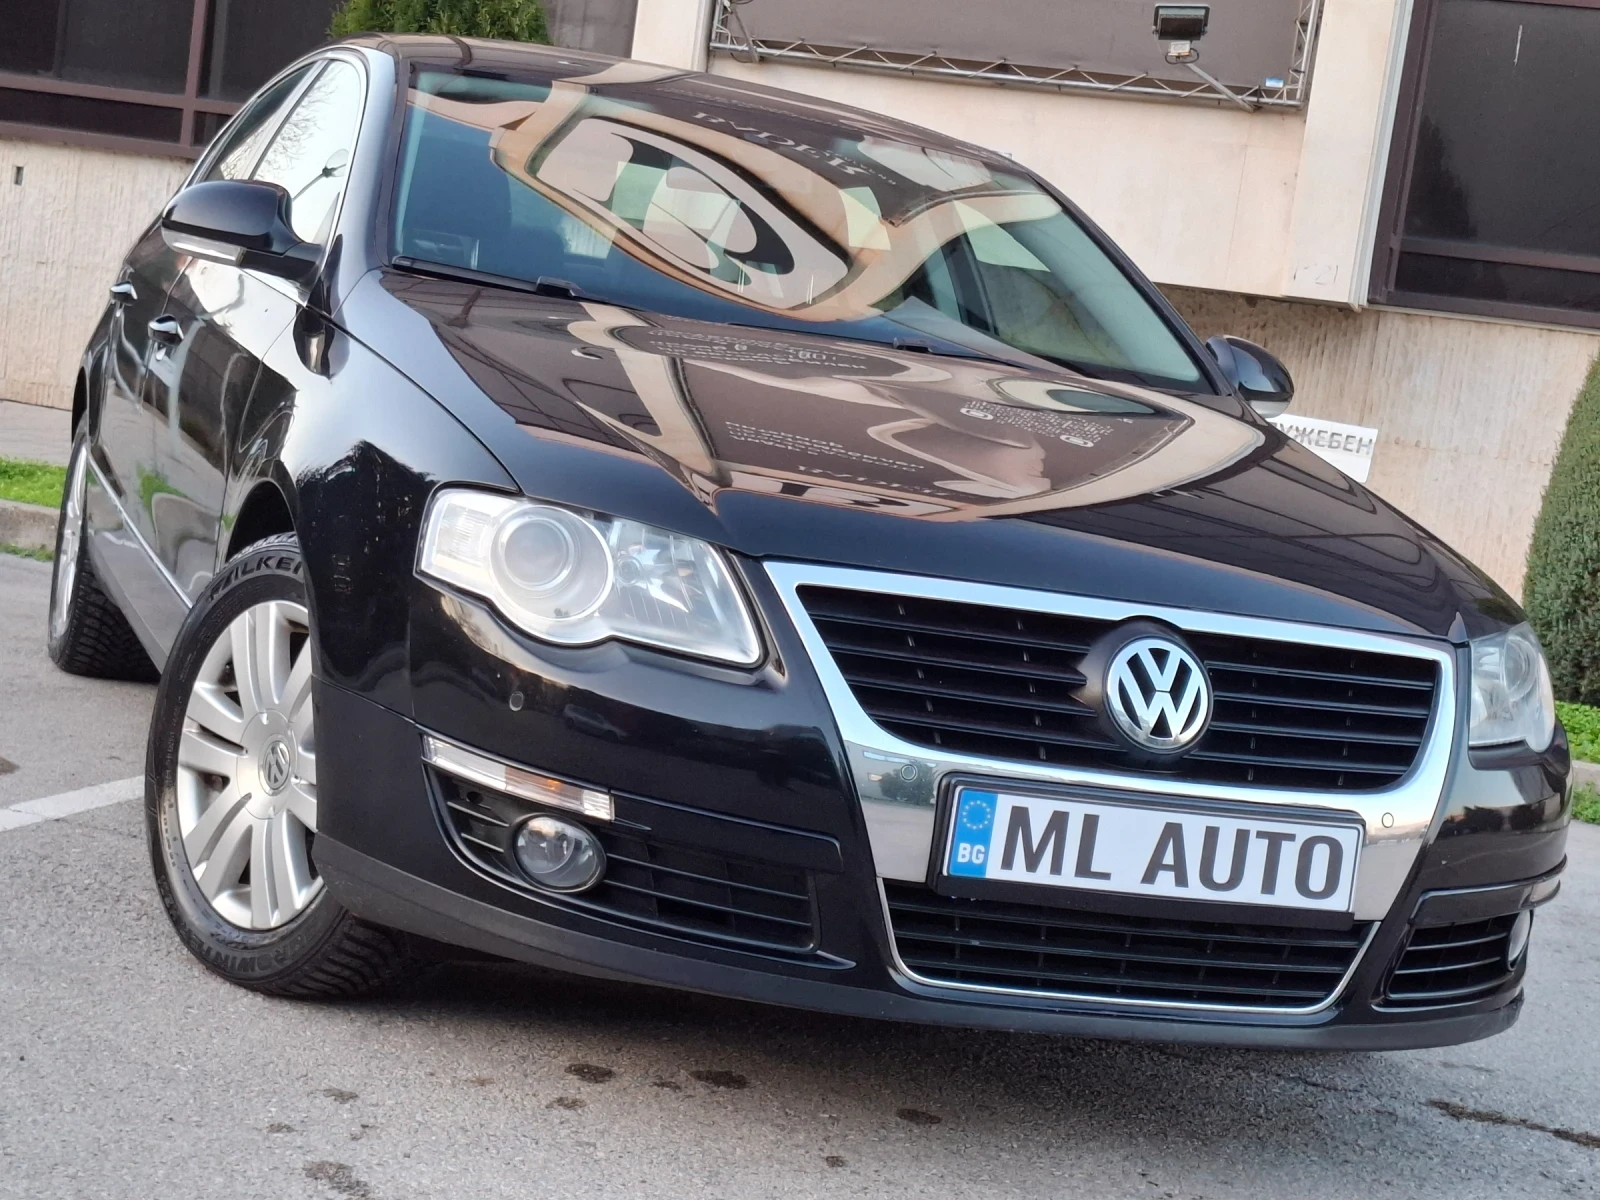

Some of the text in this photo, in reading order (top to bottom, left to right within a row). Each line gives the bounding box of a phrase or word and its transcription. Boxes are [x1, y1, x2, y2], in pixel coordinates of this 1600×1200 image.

[1270, 422, 1373, 455] УЖЕБЕН
[208, 556, 302, 600] FALKE
[958, 842, 985, 864] BG
[1000, 805, 1344, 900] ML AUTO
